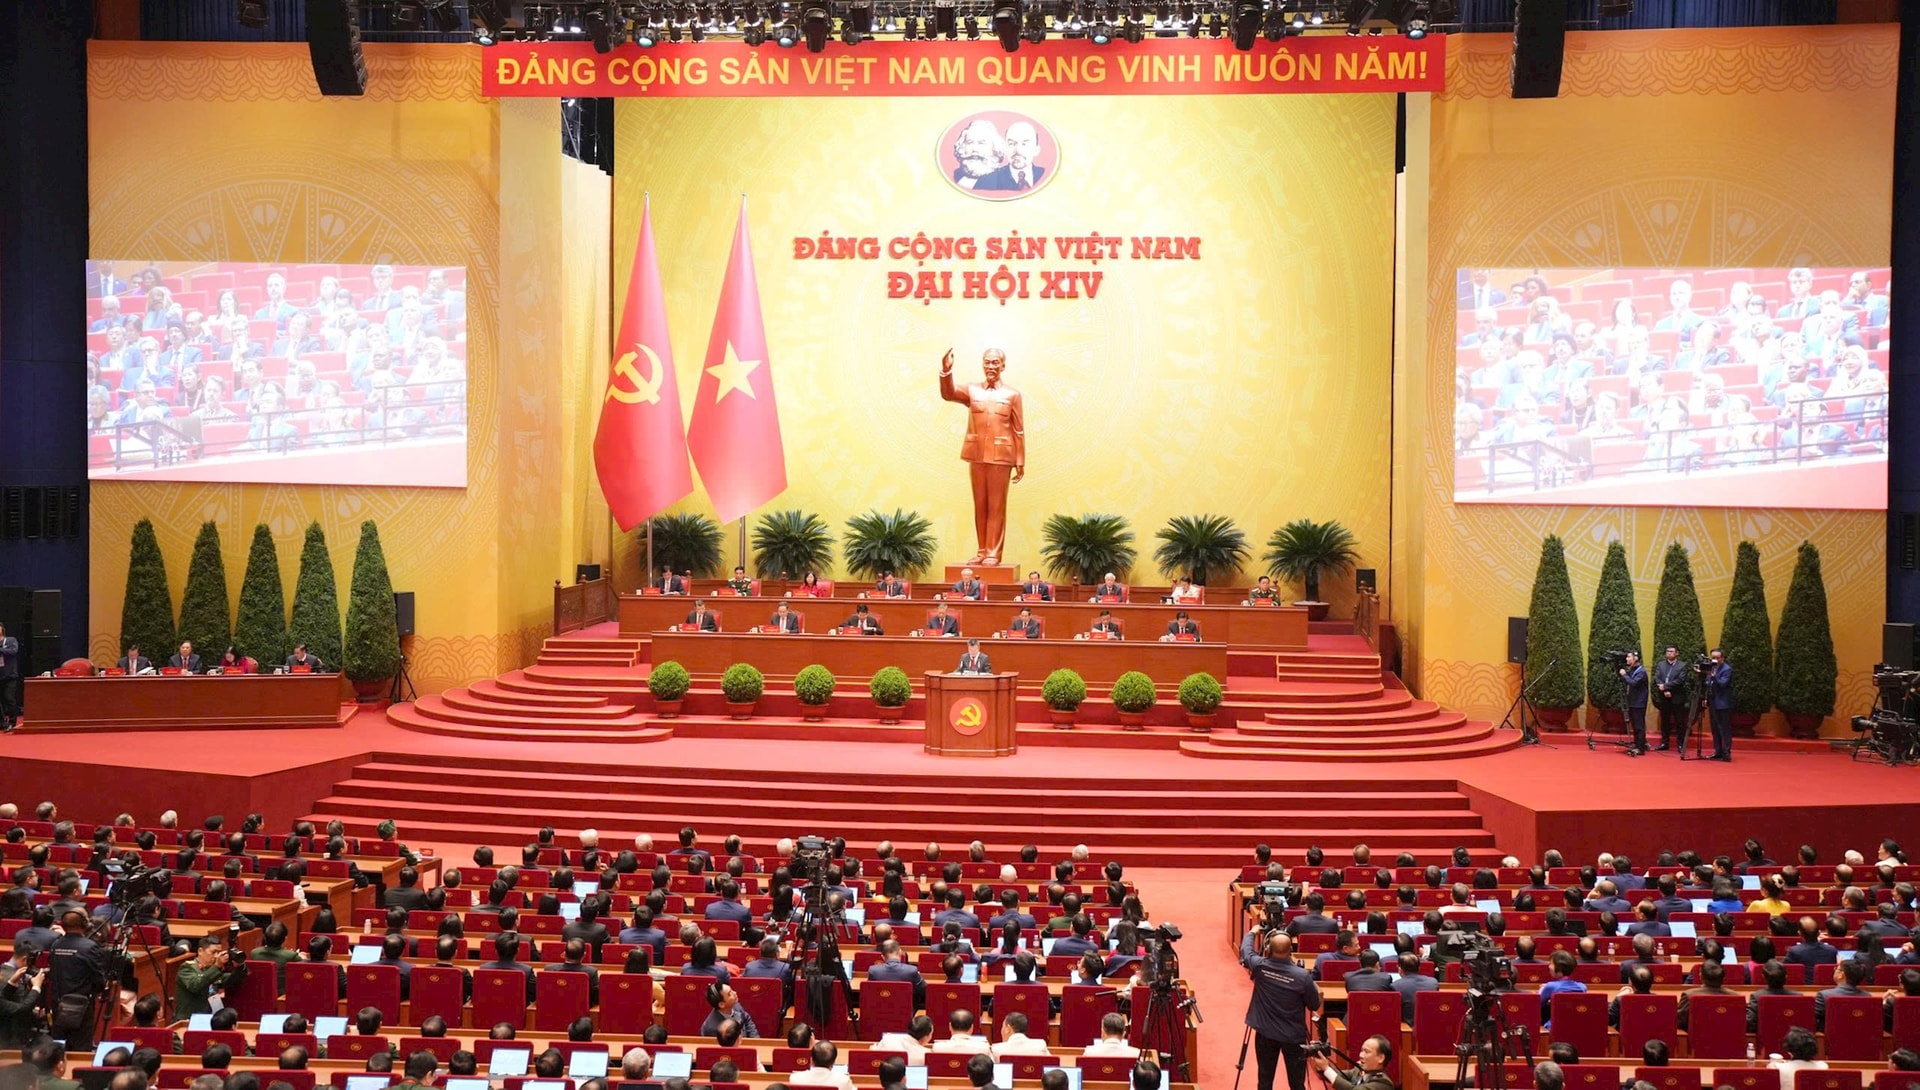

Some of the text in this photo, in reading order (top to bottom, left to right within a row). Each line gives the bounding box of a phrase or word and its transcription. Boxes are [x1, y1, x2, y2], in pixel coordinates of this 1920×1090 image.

[496, 46, 1427, 91] ĐẢNG CỘNG SẢN VIỆT NAM QUANG VINH MUÔN NĂM!
[794, 230, 1201, 266] ĐẢNG CỘNG SẢN VIỆT NAM
[887, 264, 1104, 305] ĐẠI HỘI XIV
